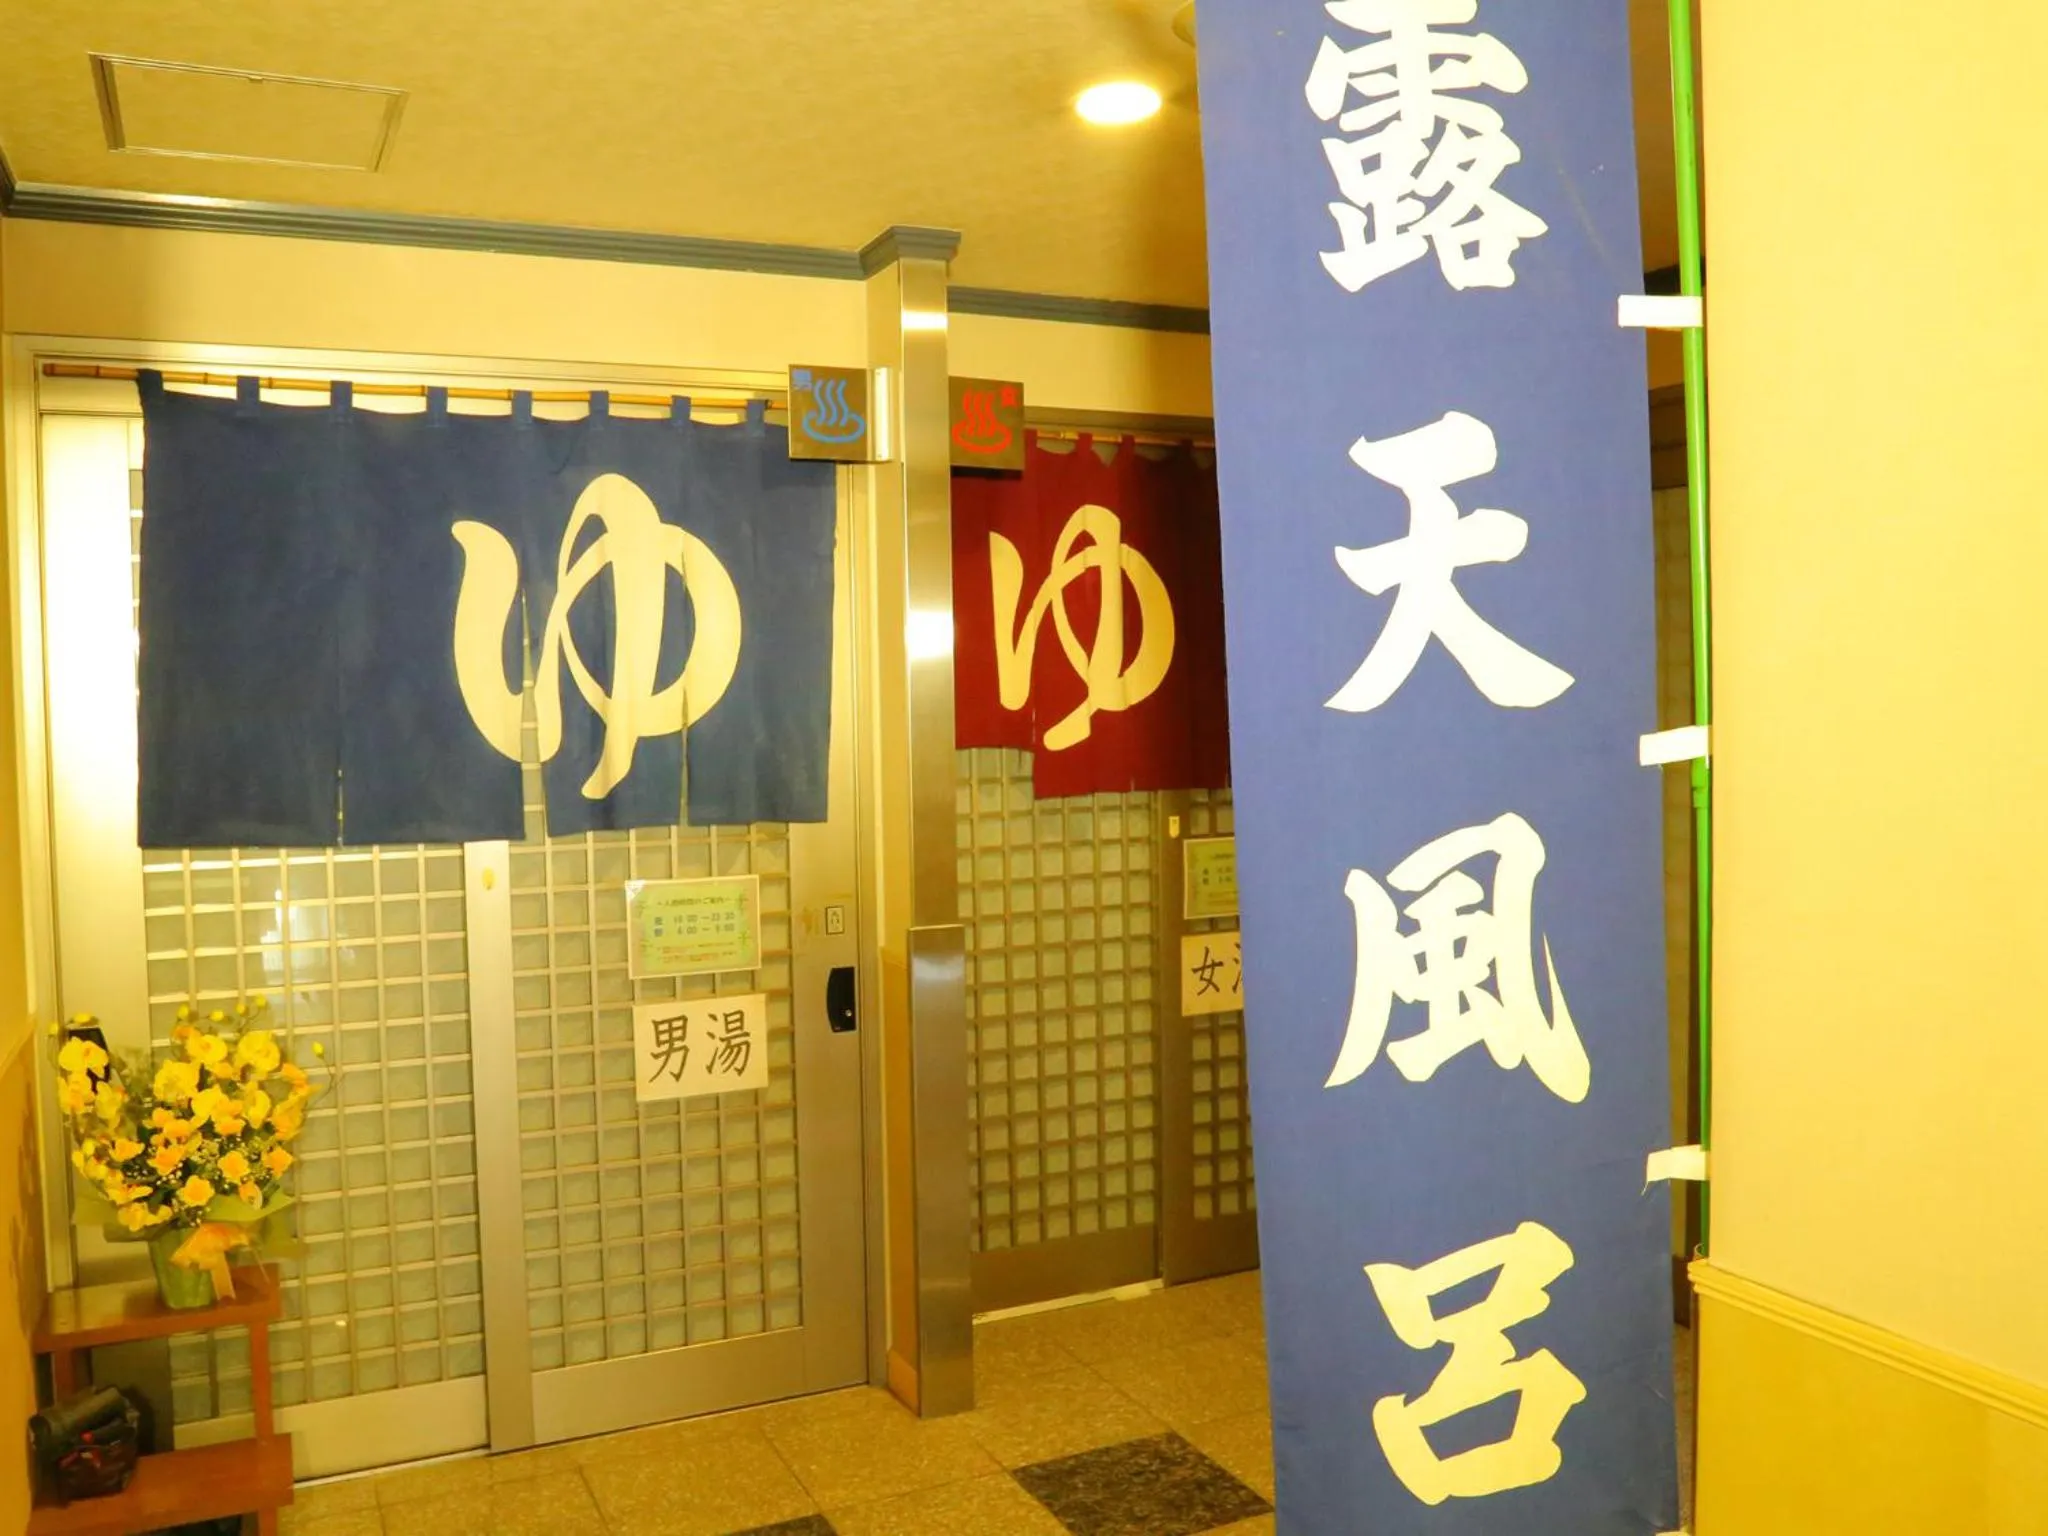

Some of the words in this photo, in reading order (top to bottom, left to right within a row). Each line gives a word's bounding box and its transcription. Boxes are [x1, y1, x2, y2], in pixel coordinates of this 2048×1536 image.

[452, 473, 742, 800] ゆ
[990, 504, 1176, 752] ゆ
[1305, 0, 1591, 1505] 露天風呂
[649, 1009, 752, 1083] 男湯
[1191, 943, 1243, 996] 女
